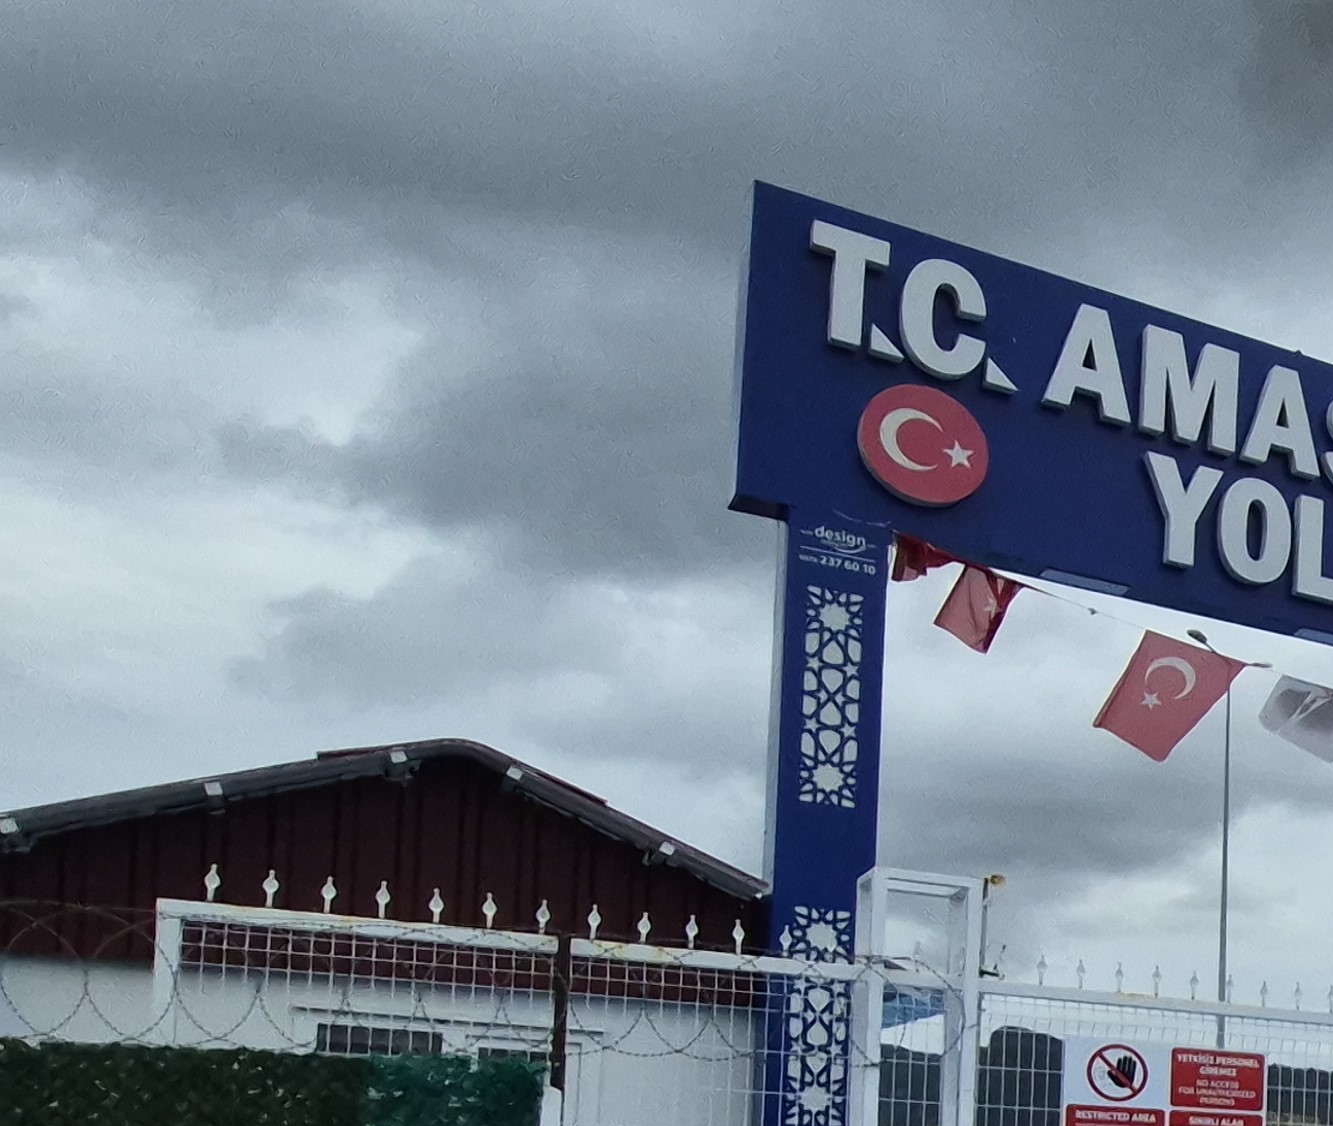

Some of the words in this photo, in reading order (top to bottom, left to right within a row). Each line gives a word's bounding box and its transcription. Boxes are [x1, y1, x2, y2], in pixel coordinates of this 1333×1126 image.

[809, 218, 1017, 393] T.C.
[814, 525, 866, 547] design
[862, 564, 876, 575] 10
